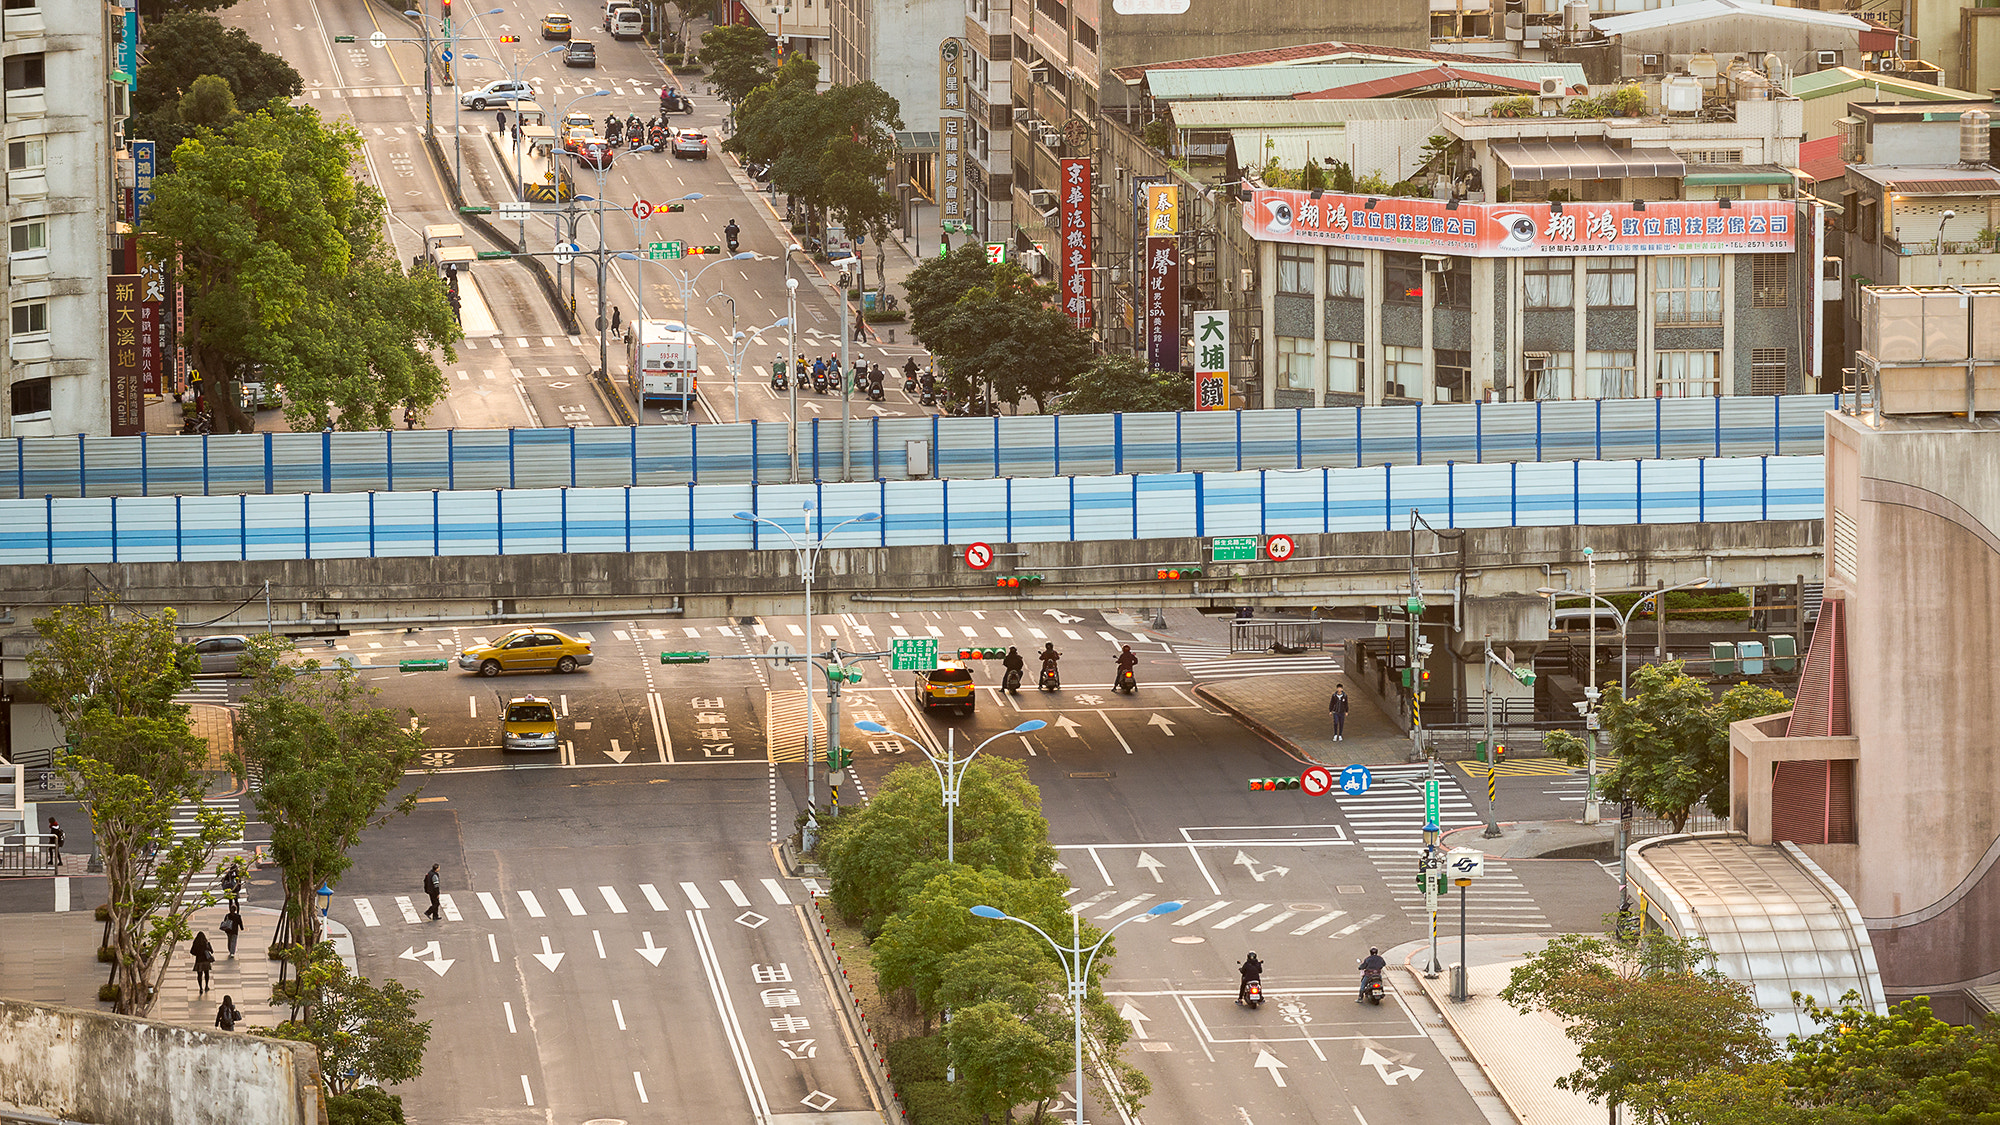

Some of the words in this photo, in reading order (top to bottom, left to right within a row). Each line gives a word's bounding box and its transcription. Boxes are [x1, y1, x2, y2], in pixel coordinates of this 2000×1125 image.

[946, 62, 958, 106] 6星集
[945, 121, 958, 215] 足體養身會館
[1352, 210, 1478, 237] 數位科技影像公司
[1621, 214, 1789, 237] 數位科技影像公司
[116, 282, 136, 368] 新大溪地
[660, 352, 679, 360] 593-FR
[1200, 315, 1225, 407] 大埔鐵
[117, 376, 126, 399] New
[118, 400, 127, 426] Tahiti
[845, 694, 906, 755] 公車用
[751, 962, 818, 1060] 公車專用
